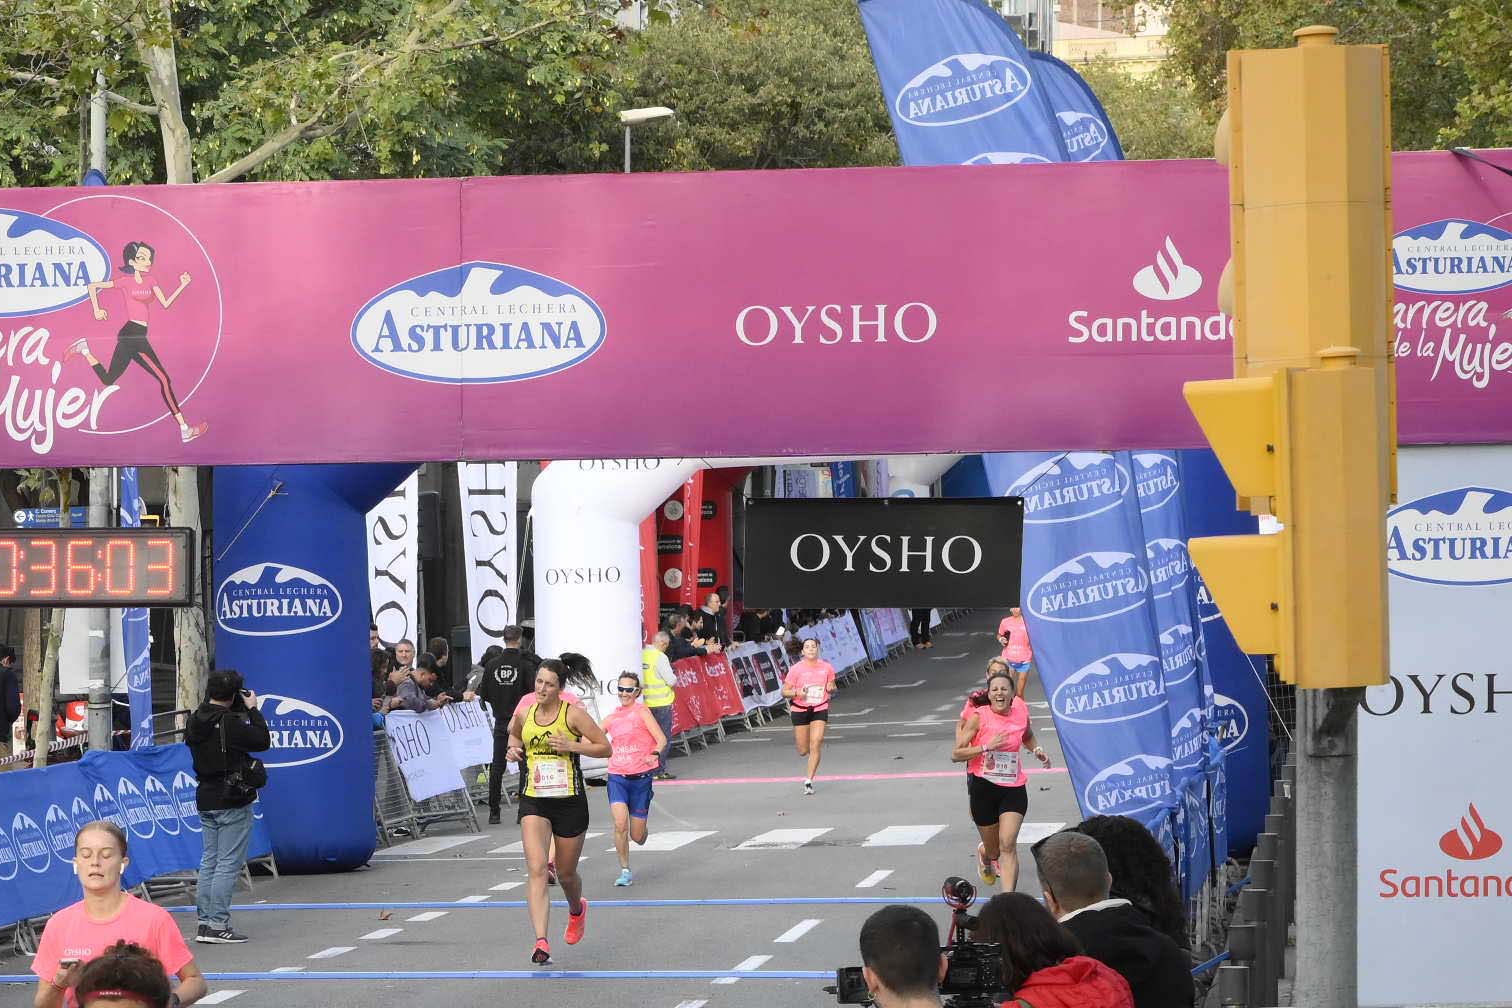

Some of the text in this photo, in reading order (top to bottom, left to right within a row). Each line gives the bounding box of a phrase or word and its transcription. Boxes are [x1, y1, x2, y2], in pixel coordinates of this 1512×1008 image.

[14, 246, 86, 256] LECHERA
[410, 303, 578, 318] CENTRAL LECHERA
[735, 302, 937, 346] OYSHO
[1393, 300, 1489, 329] arrera
[371, 309, 586, 354] ASTURIANA
[1069, 310, 1234, 343] Santand
[1431, 324, 1512, 389] Muje
[1414, 522, 1482, 531] CENTRAL
[790, 533, 983, 575] OYSHO
[545, 566, 623, 586] OYSHO
[233, 587, 328, 596] CENTRAL LECHERA
[220, 592, 333, 619] ASTURIANA
[280, 719, 328, 727] LECHERA
